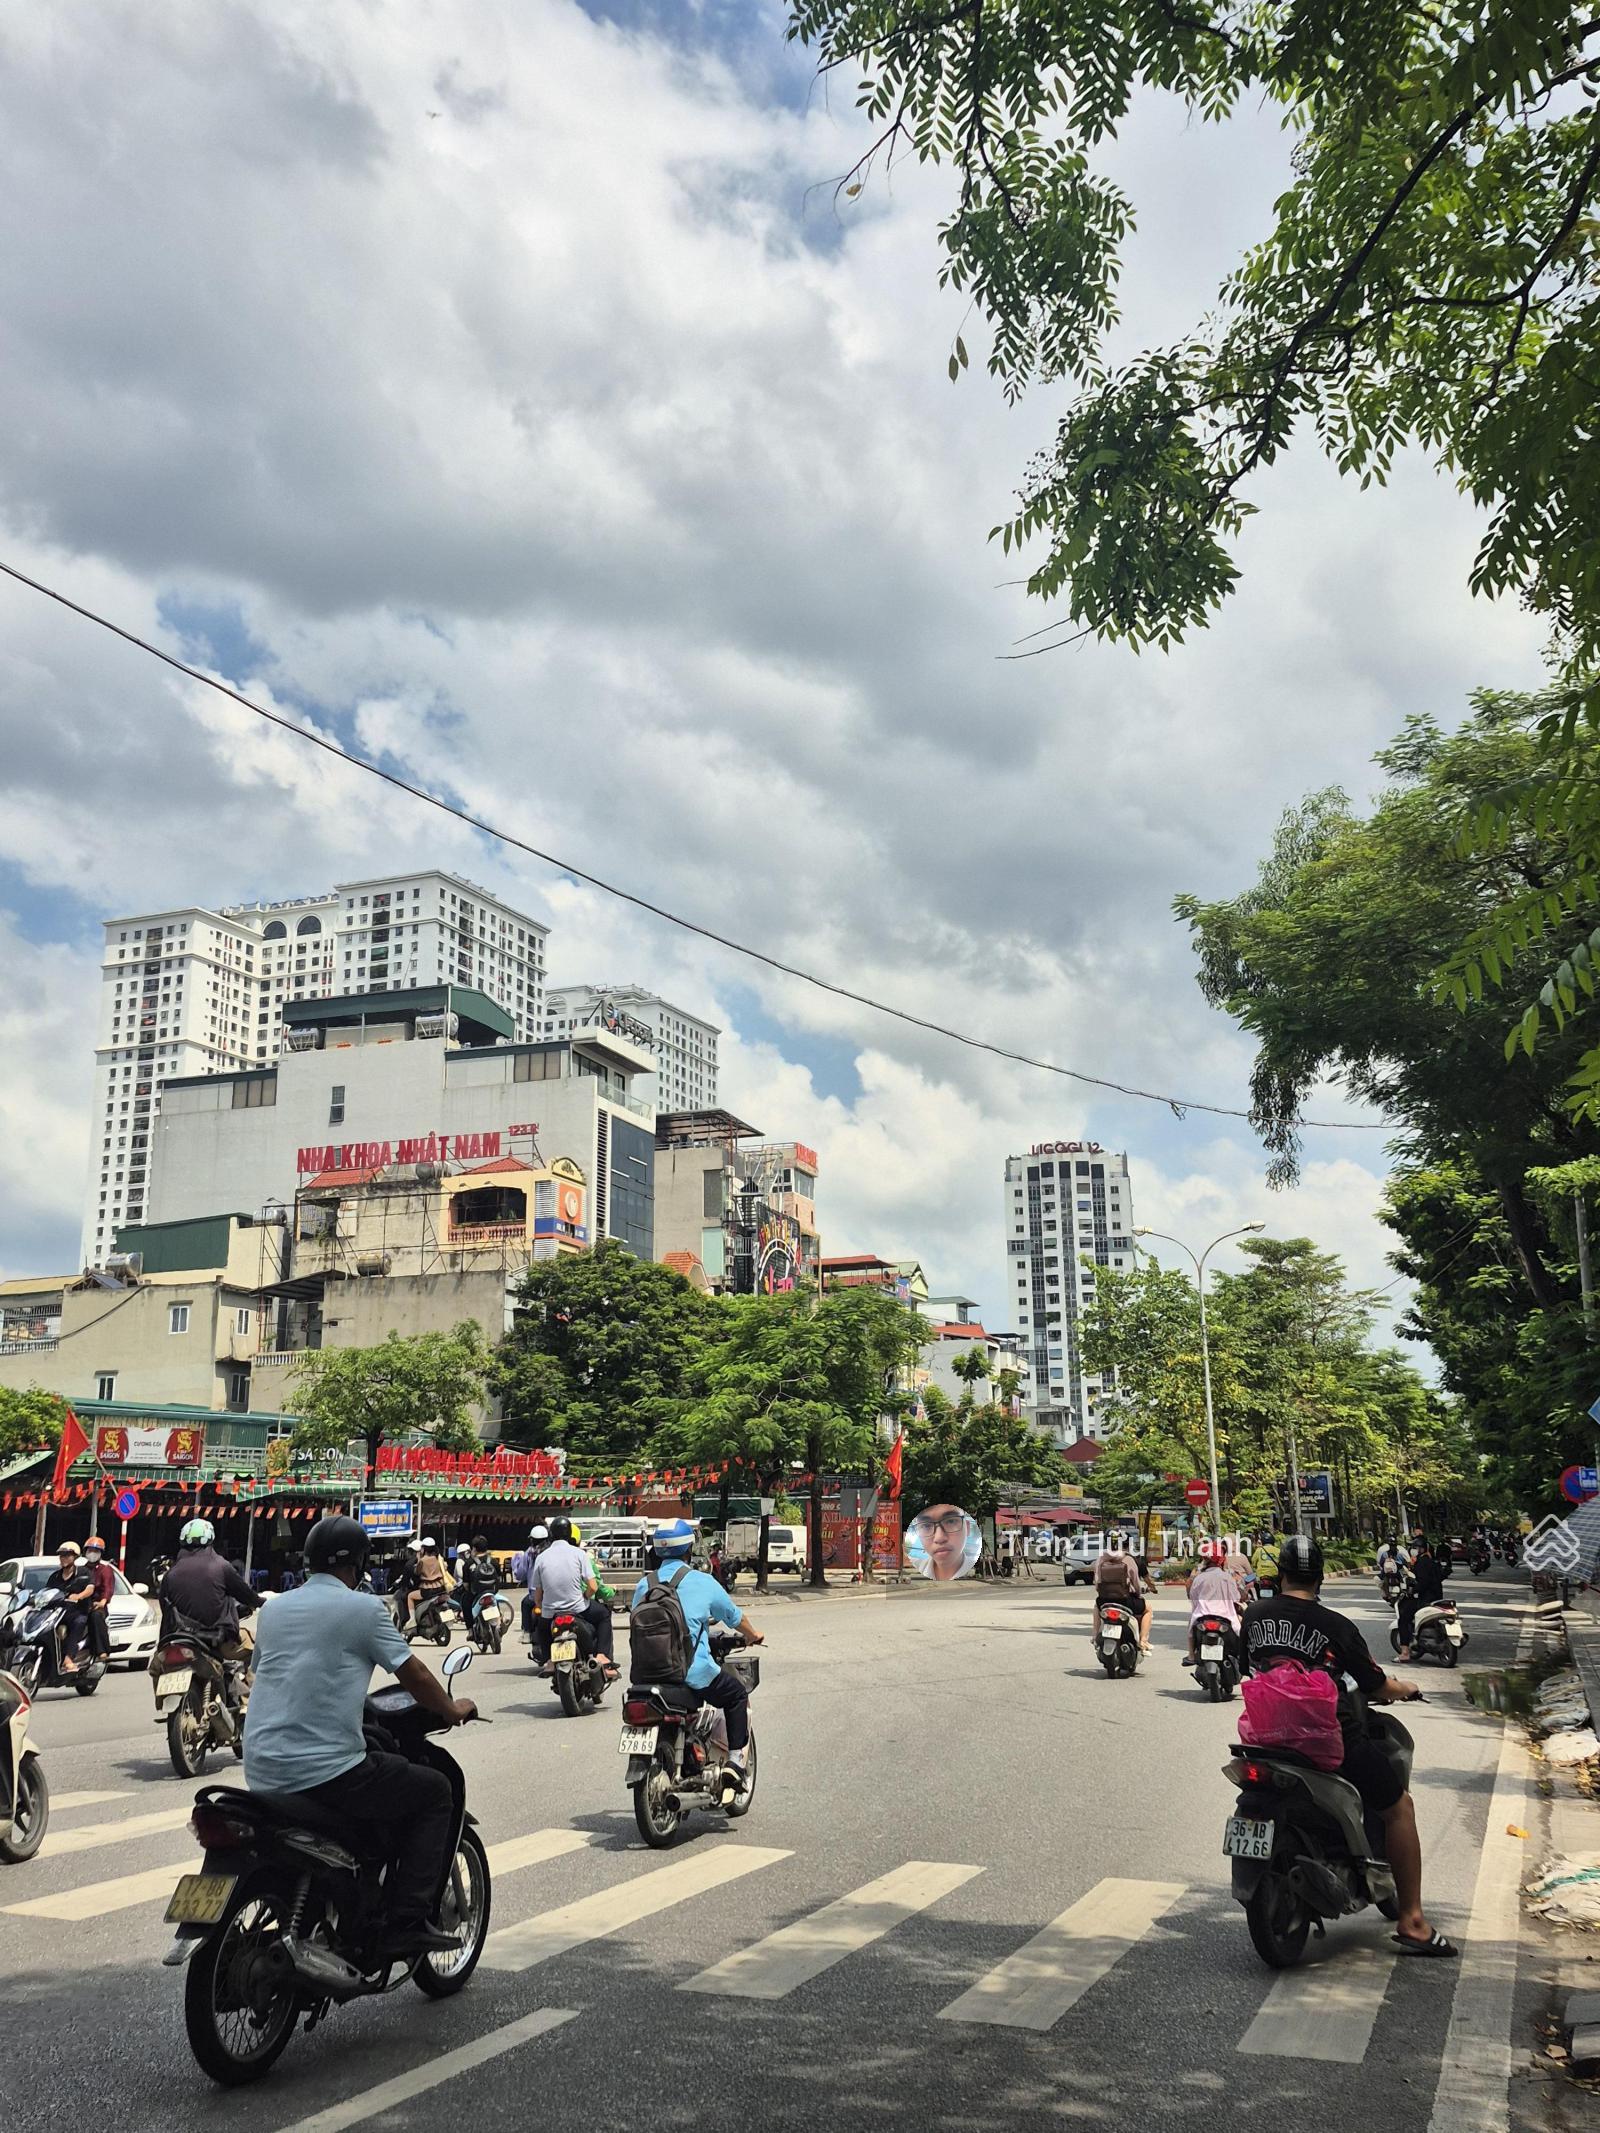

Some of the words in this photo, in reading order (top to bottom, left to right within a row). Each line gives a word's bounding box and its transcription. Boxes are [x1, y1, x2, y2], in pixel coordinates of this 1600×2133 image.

[297, 1145, 336, 1172] NHA
[341, 1141, 392, 1169] KHOA
[455, 1132, 500, 1159] NAM
[1087, 1141, 1101, 1155] 12
[100, 1451, 120, 1459] SAIGON
[173, 1452, 193, 1460] SAIGON
[1247, 1619, 1329, 1658] JORDAN
[1232, 1821, 1267, 1839] 36-AB
